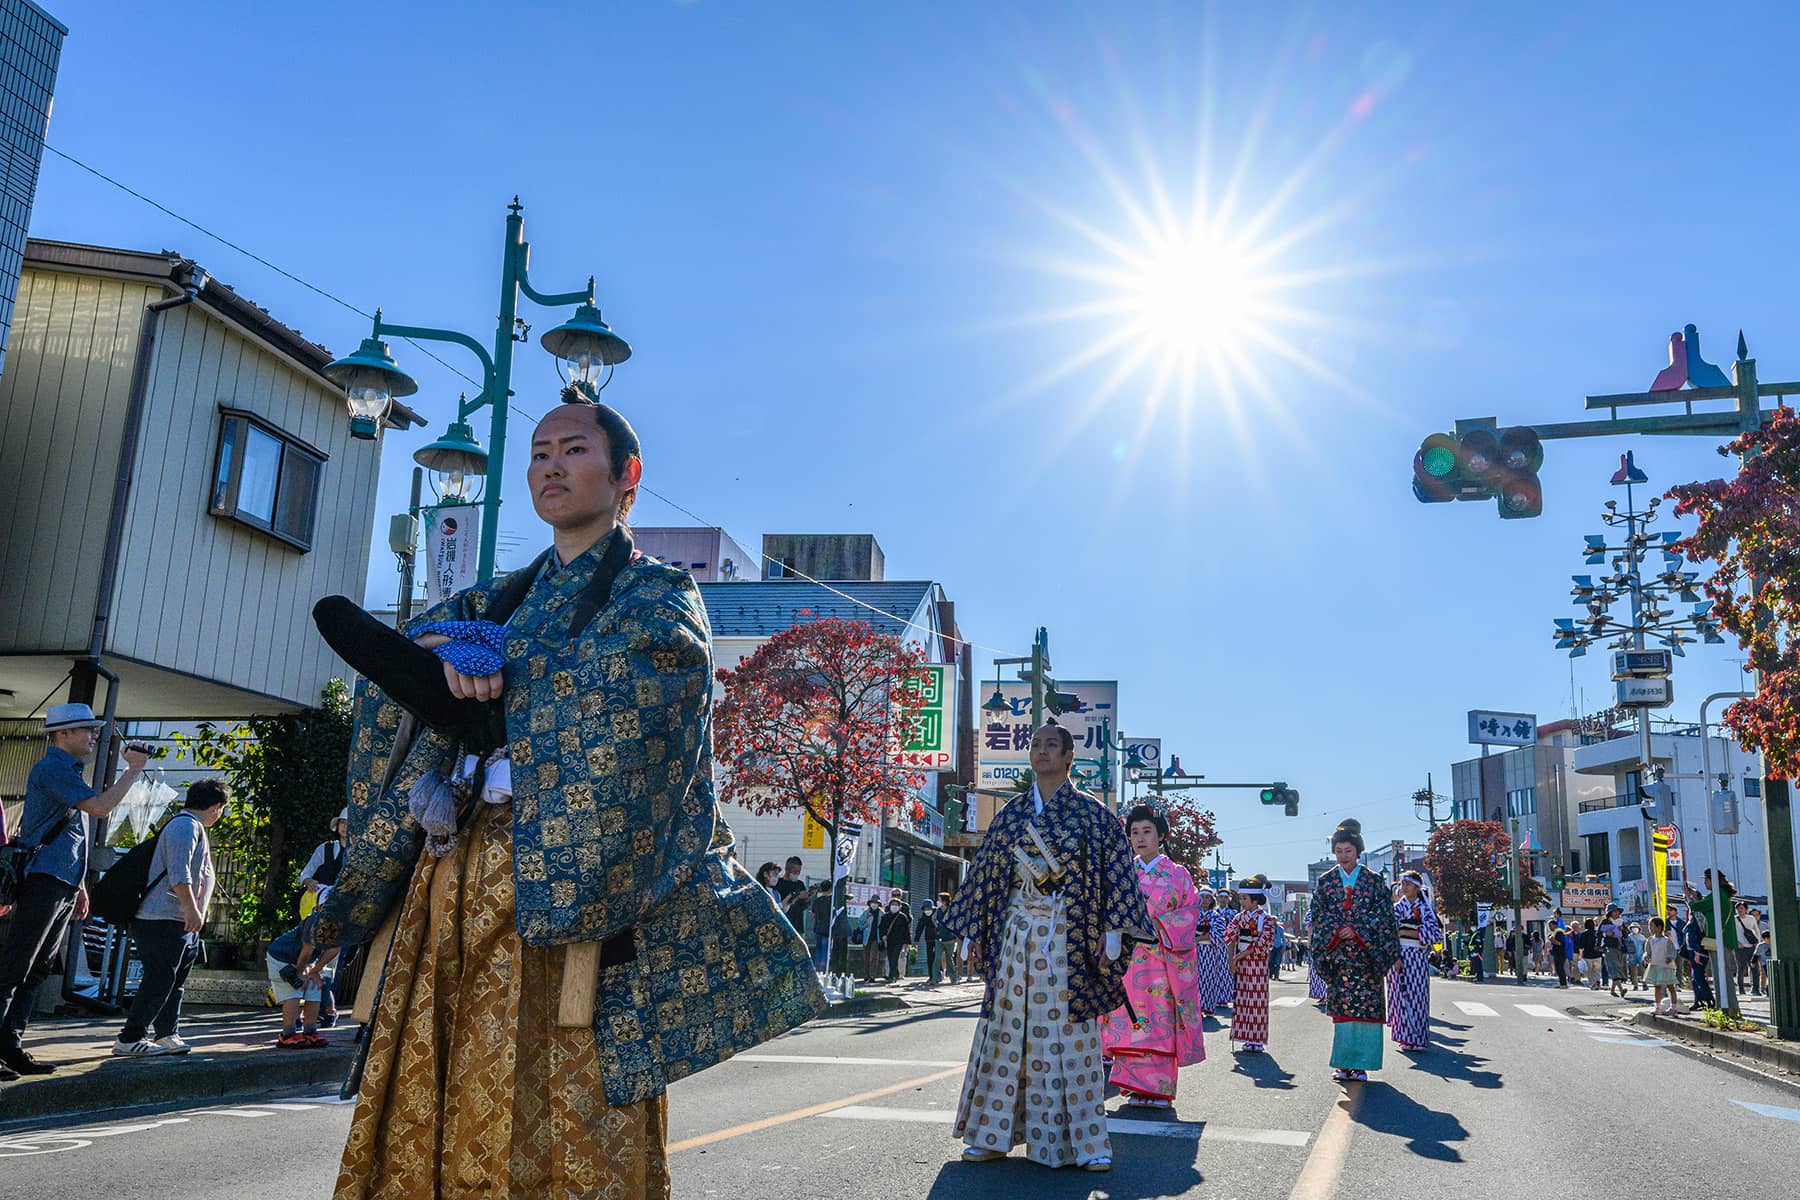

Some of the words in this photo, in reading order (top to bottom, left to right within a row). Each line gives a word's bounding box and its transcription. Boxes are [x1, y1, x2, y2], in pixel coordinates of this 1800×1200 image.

[985, 724, 1104, 751] 岩槻ール
[938, 753, 950, 767] P
